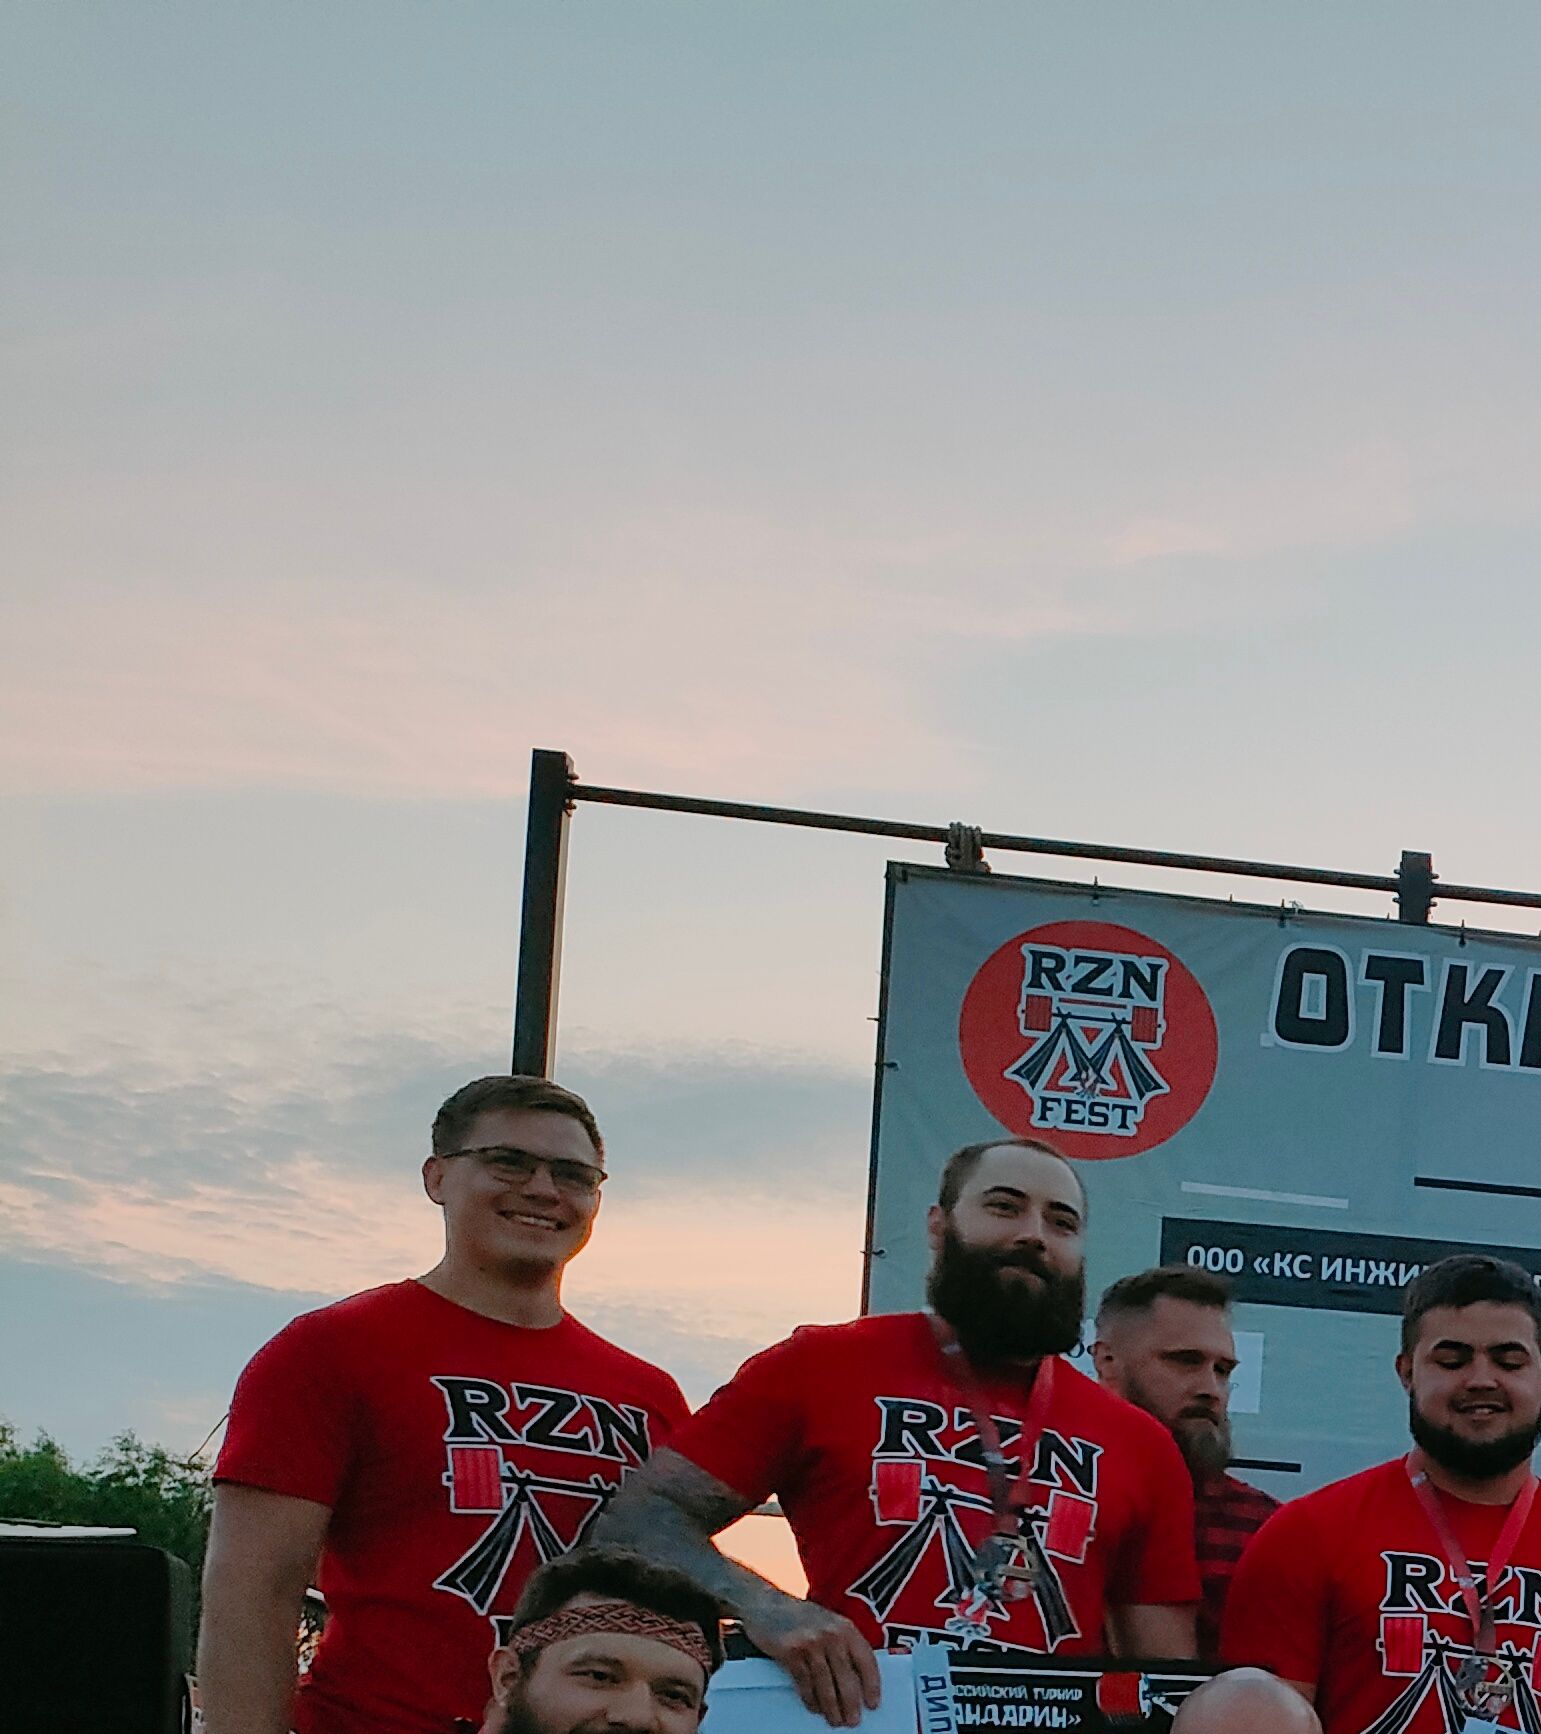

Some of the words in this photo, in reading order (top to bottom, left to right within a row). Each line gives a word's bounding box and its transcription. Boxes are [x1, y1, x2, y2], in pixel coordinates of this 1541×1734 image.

[1025, 947, 1167, 1002] RZN
[1035, 1095, 1140, 1130] FEST
[1187, 1245, 1244, 1274] ООО
[1253, 1252, 1313, 1280] «КС
[431, 1375, 652, 1467] RZN
[873, 1395, 1104, 1497] RZN
